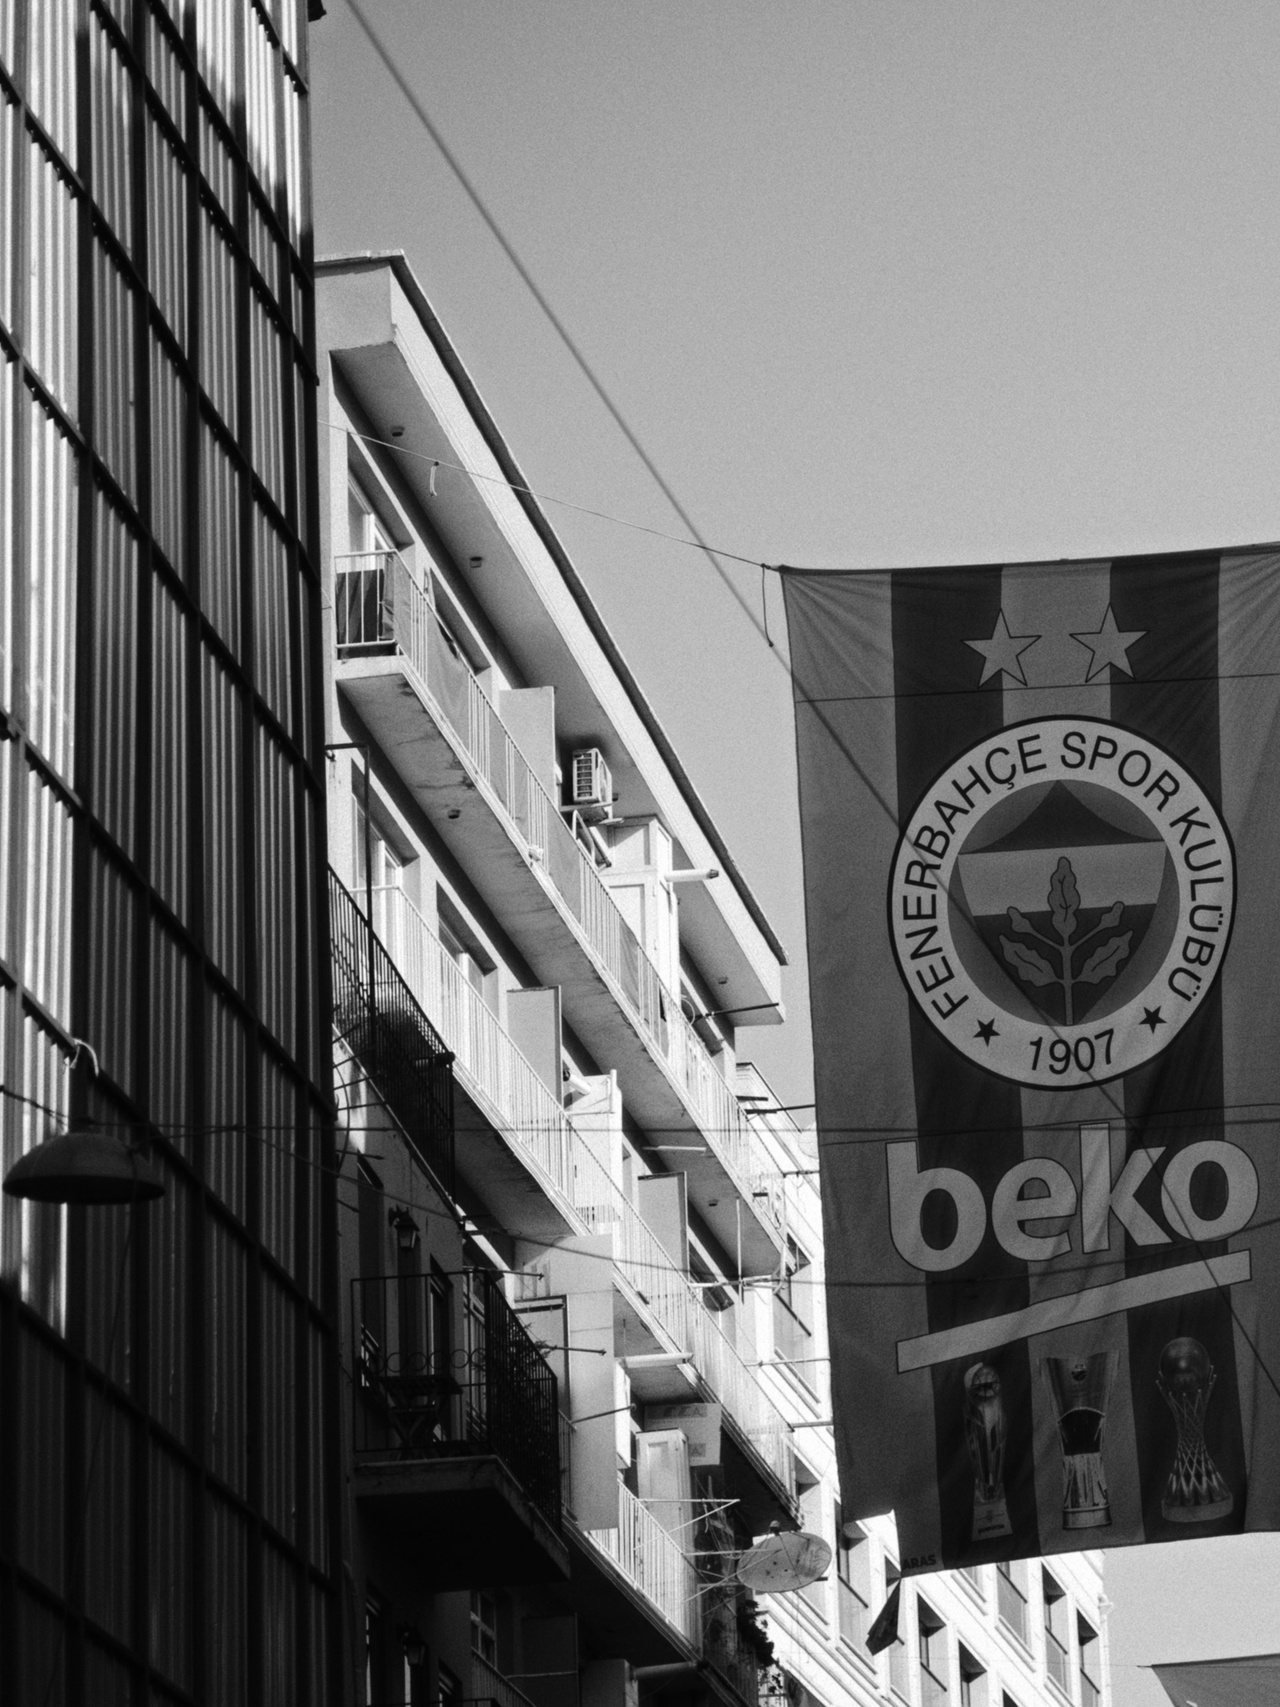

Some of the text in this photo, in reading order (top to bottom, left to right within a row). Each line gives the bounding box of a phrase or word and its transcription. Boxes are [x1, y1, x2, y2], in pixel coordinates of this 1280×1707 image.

[903, 731, 1226, 1020] FENERBAHÇE SPOR KULÜBÜ
[1029, 1028, 1117, 1076] 1907
[886, 1122, 1260, 1273] beko
